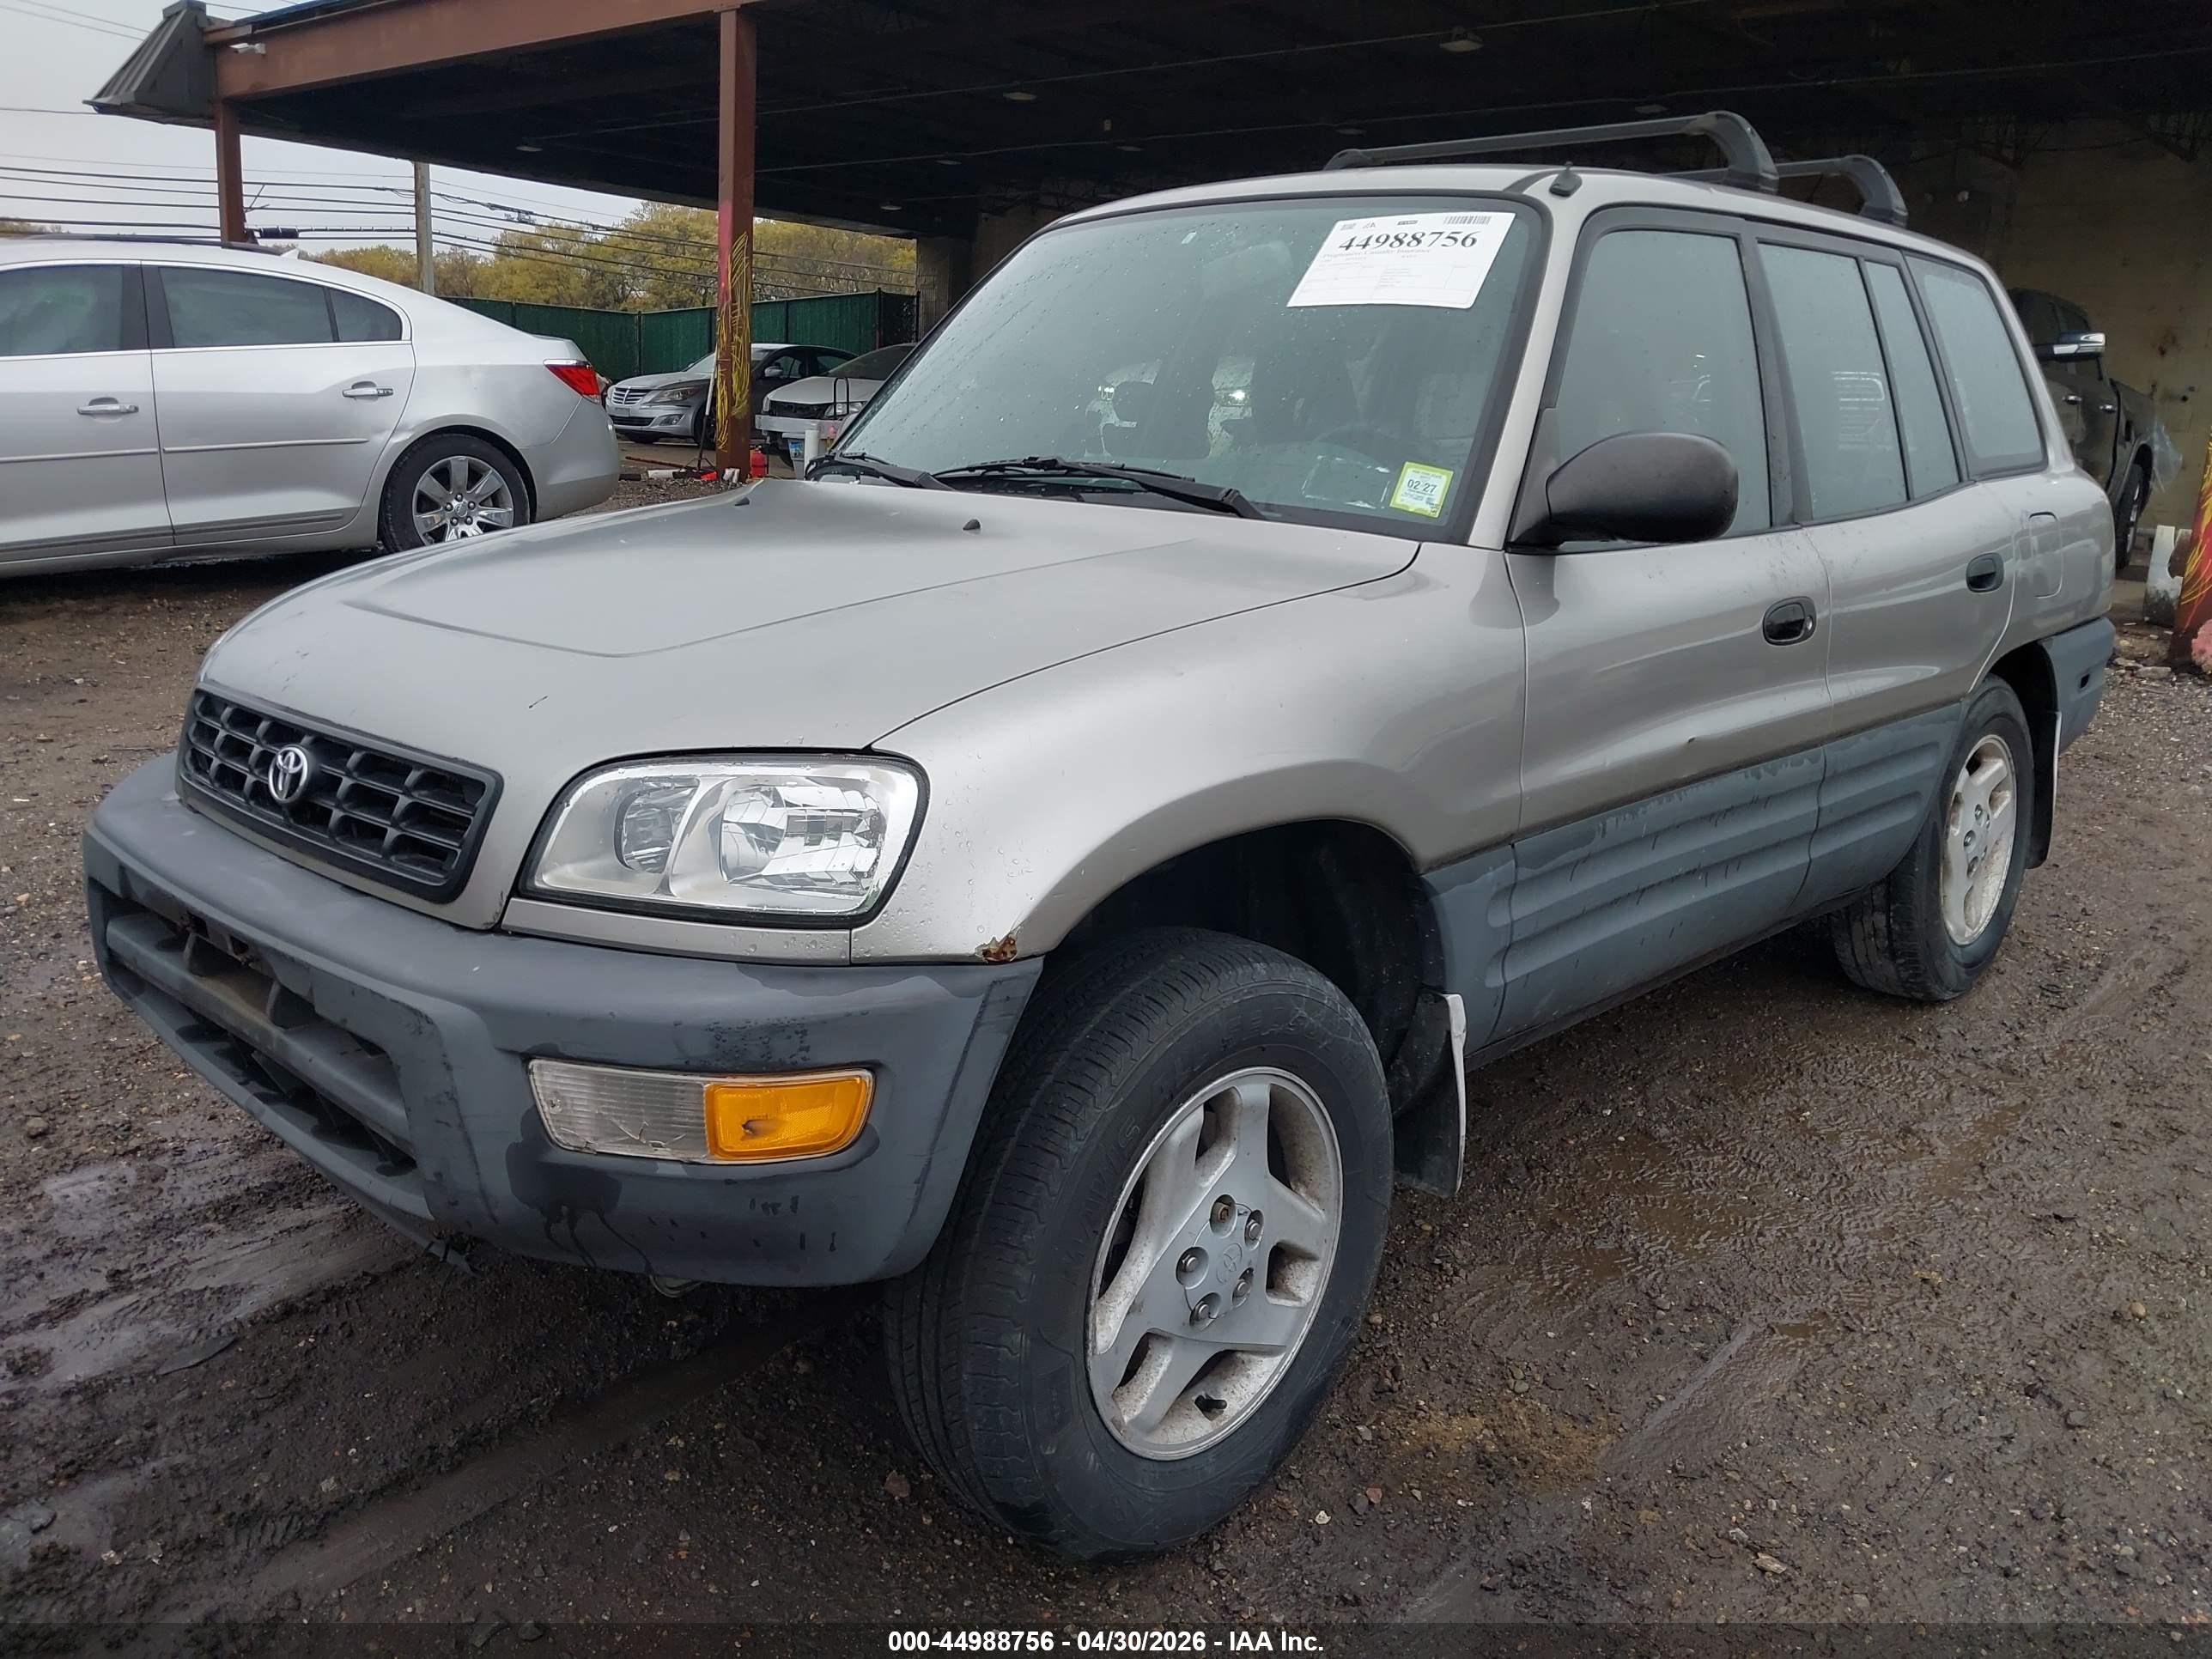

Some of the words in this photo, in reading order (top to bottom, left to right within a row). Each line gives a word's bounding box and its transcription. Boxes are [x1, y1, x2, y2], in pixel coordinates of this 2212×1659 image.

[1339, 231, 1480, 251] 44988756
[1407, 478, 1421, 490] 02
[1422, 482, 1437, 494] 27
